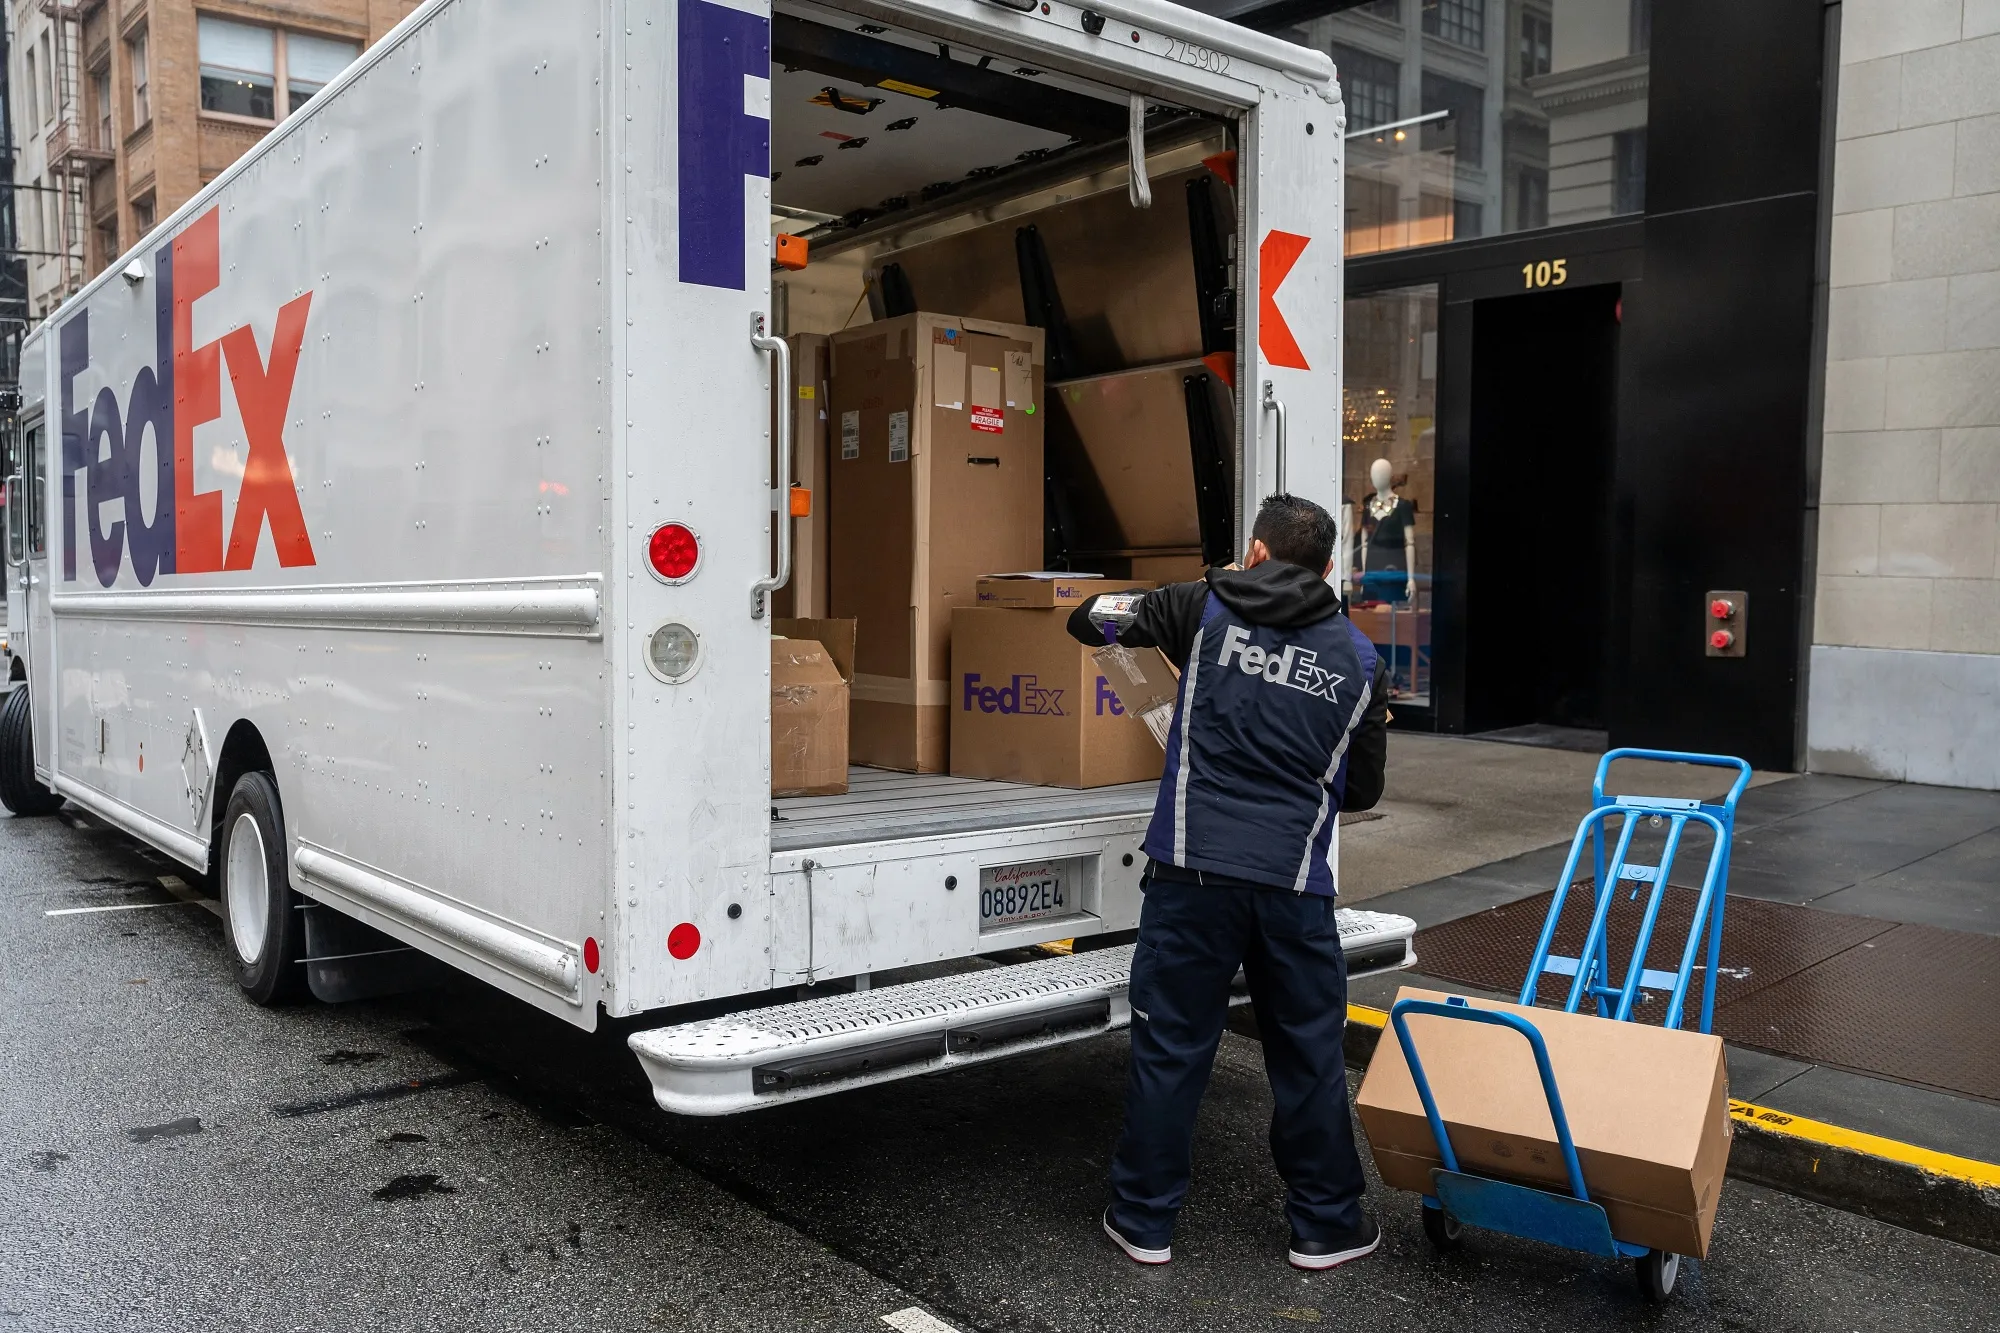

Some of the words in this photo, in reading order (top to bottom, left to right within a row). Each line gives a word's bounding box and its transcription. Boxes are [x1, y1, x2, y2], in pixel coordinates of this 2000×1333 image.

[1164, 36, 1231, 78] 275902
[1522, 259, 1567, 289] 105
[59, 203, 317, 589] FedEx
[974, 416, 1000, 427] FRAGILE
[1217, 624, 1347, 704] FedEx
[963, 673, 1065, 716] FedEx
[992, 866, 1051, 885] California
[981, 880, 1064, 919] 08892E4
[998, 911, 1047, 923] dmv.ca.gov
